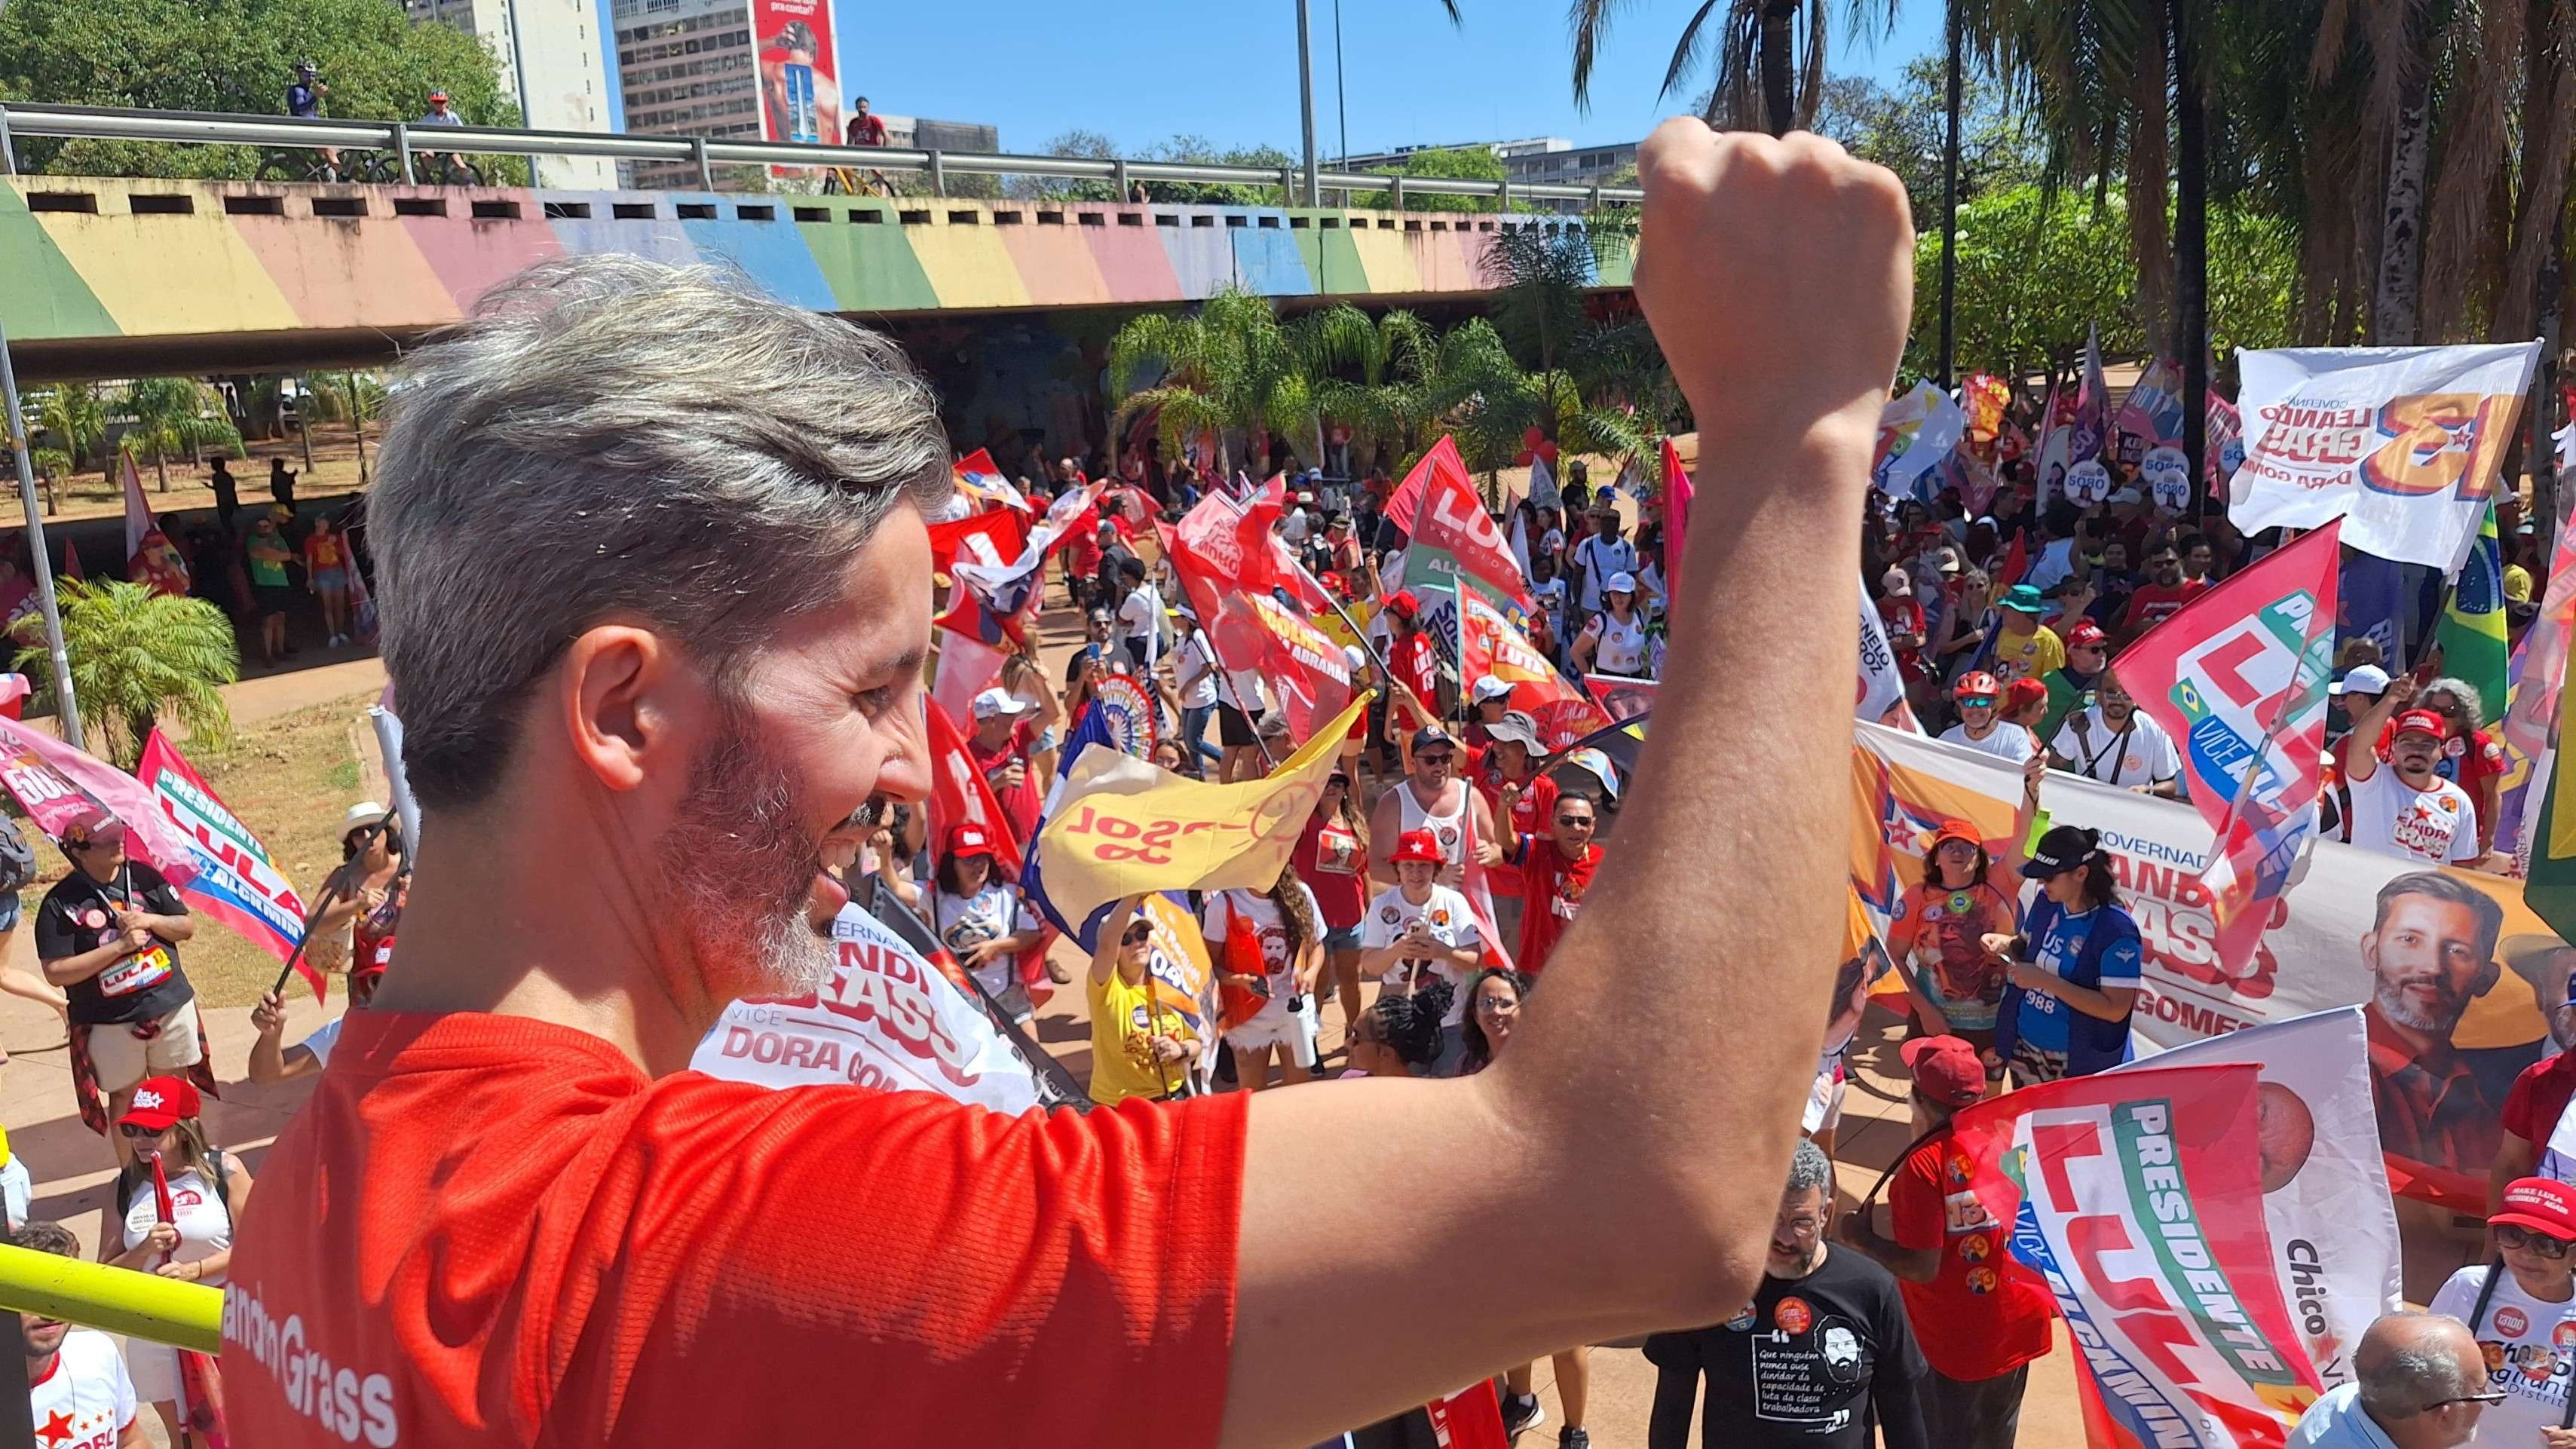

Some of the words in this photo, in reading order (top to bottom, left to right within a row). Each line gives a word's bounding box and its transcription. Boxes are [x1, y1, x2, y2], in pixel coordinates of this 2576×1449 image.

[2194, 718, 2250, 767] VICE
[161, 795, 306, 924] LULA
[210, 865, 301, 940] ALCKMIN
[103, 960, 152, 988] LULA
[731, 1007, 782, 1026] VICE
[721, 1025, 841, 1072] DORA
[2537, 1189, 2562, 1204] LULA
[2542, 1199, 2569, 1215] AGAIN
[2131, 1104, 2283, 1372] PRESIDENTE
[2287, 1238, 2327, 1335] Chico
[1759, 1349, 1778, 1360] Que
[1779, 1349, 1820, 1362] ninguém
[1798, 1372, 1810, 1381] da
[1761, 1382, 1811, 1393] capacidade
[1813, 1383, 1825, 1392] de
[1762, 1390, 1780, 1401] luta
[1782, 1392, 1794, 1402] da
[1796, 1394, 1821, 1403] classe
[1762, 1402, 1821, 1414] trabalhadora
